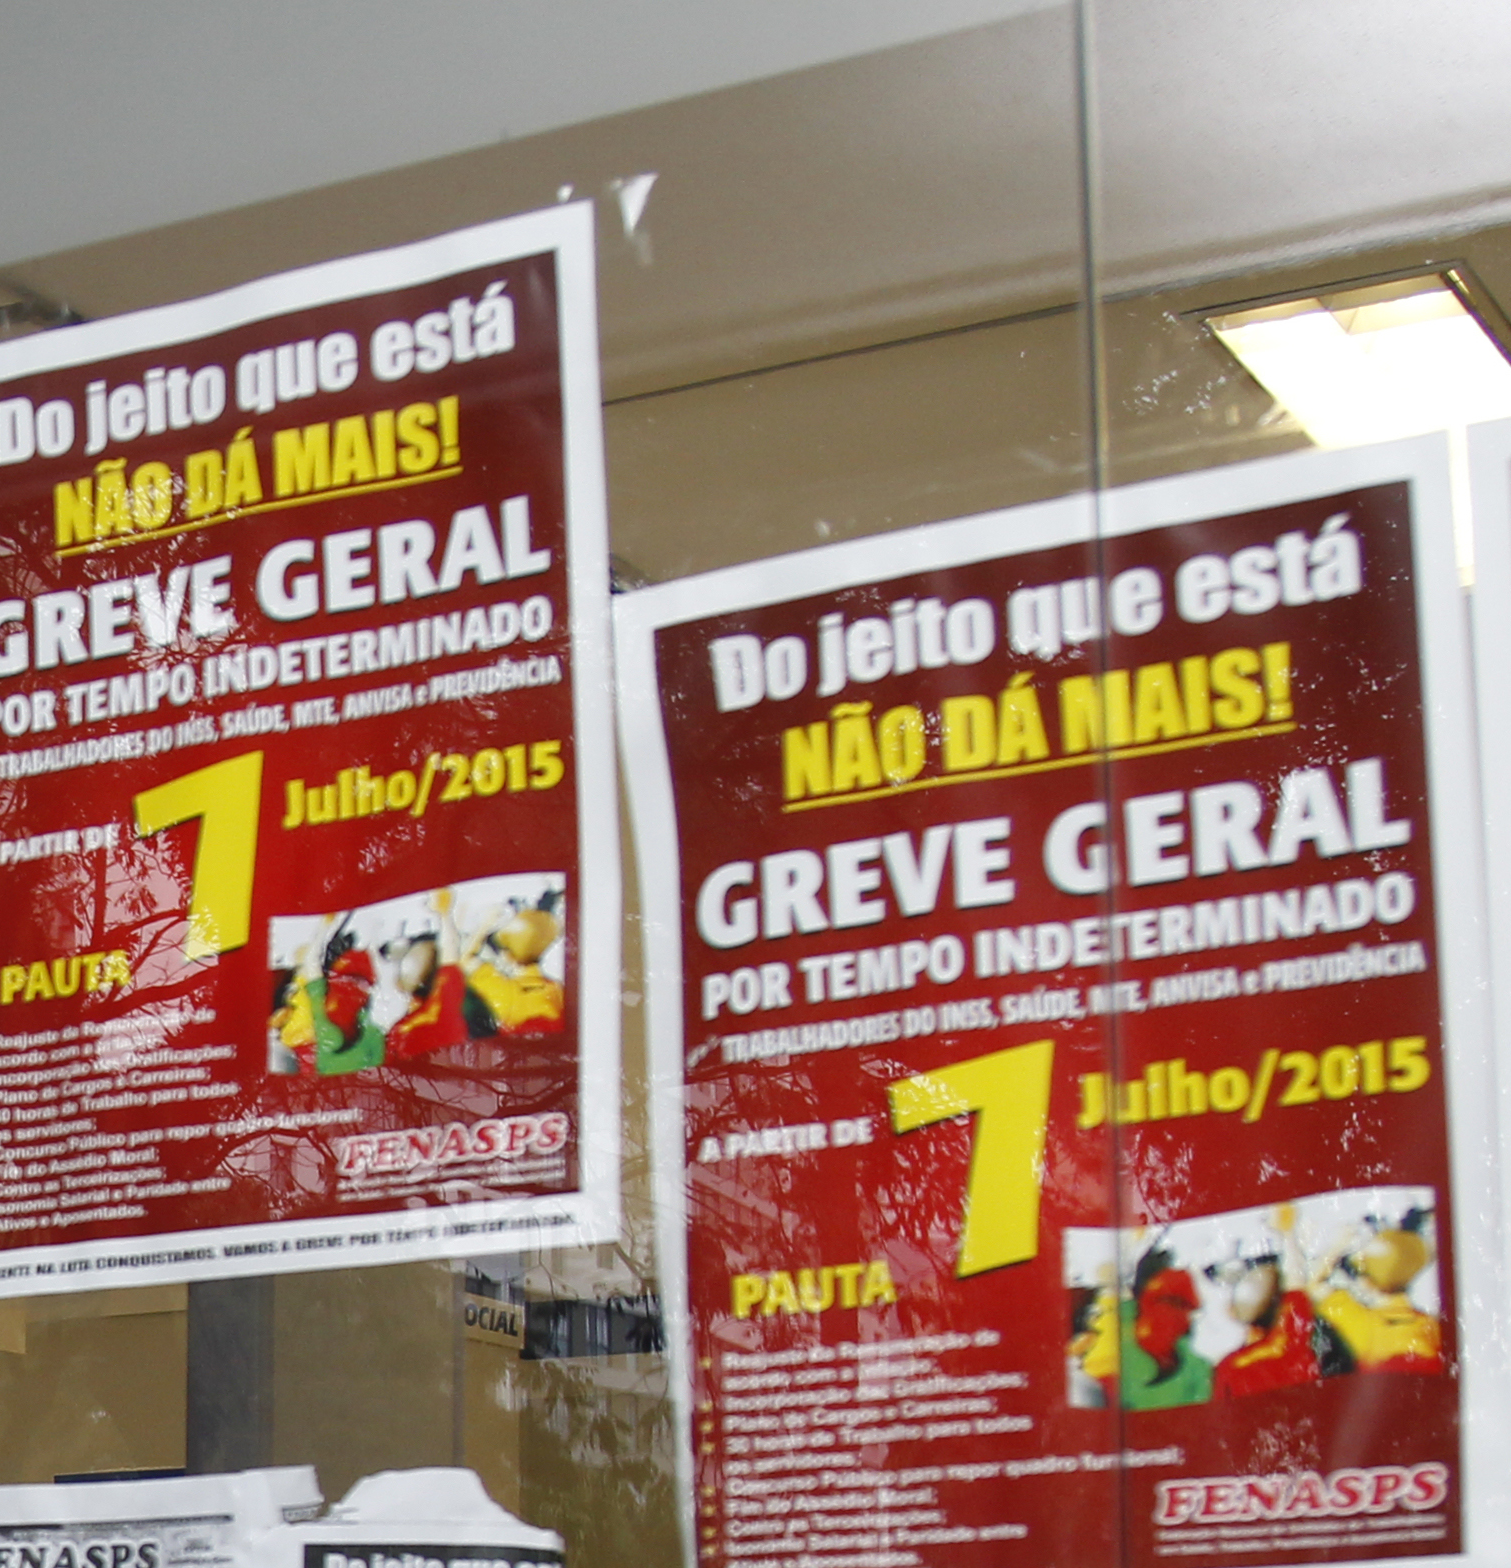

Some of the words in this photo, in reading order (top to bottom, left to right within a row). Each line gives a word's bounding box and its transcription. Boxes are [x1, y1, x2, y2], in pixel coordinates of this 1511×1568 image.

[54, 458, 172, 546] NÃO
[184, 429, 262, 521] DÁ
[274, 395, 461, 502] MAIS!
[256, 496, 552, 622] GERAL
[891, 1040, 1054, 1279] 7
[1077, 1037, 1431, 1120] Julho/2015
[1154, 1462, 1448, 1524] FENASPS
